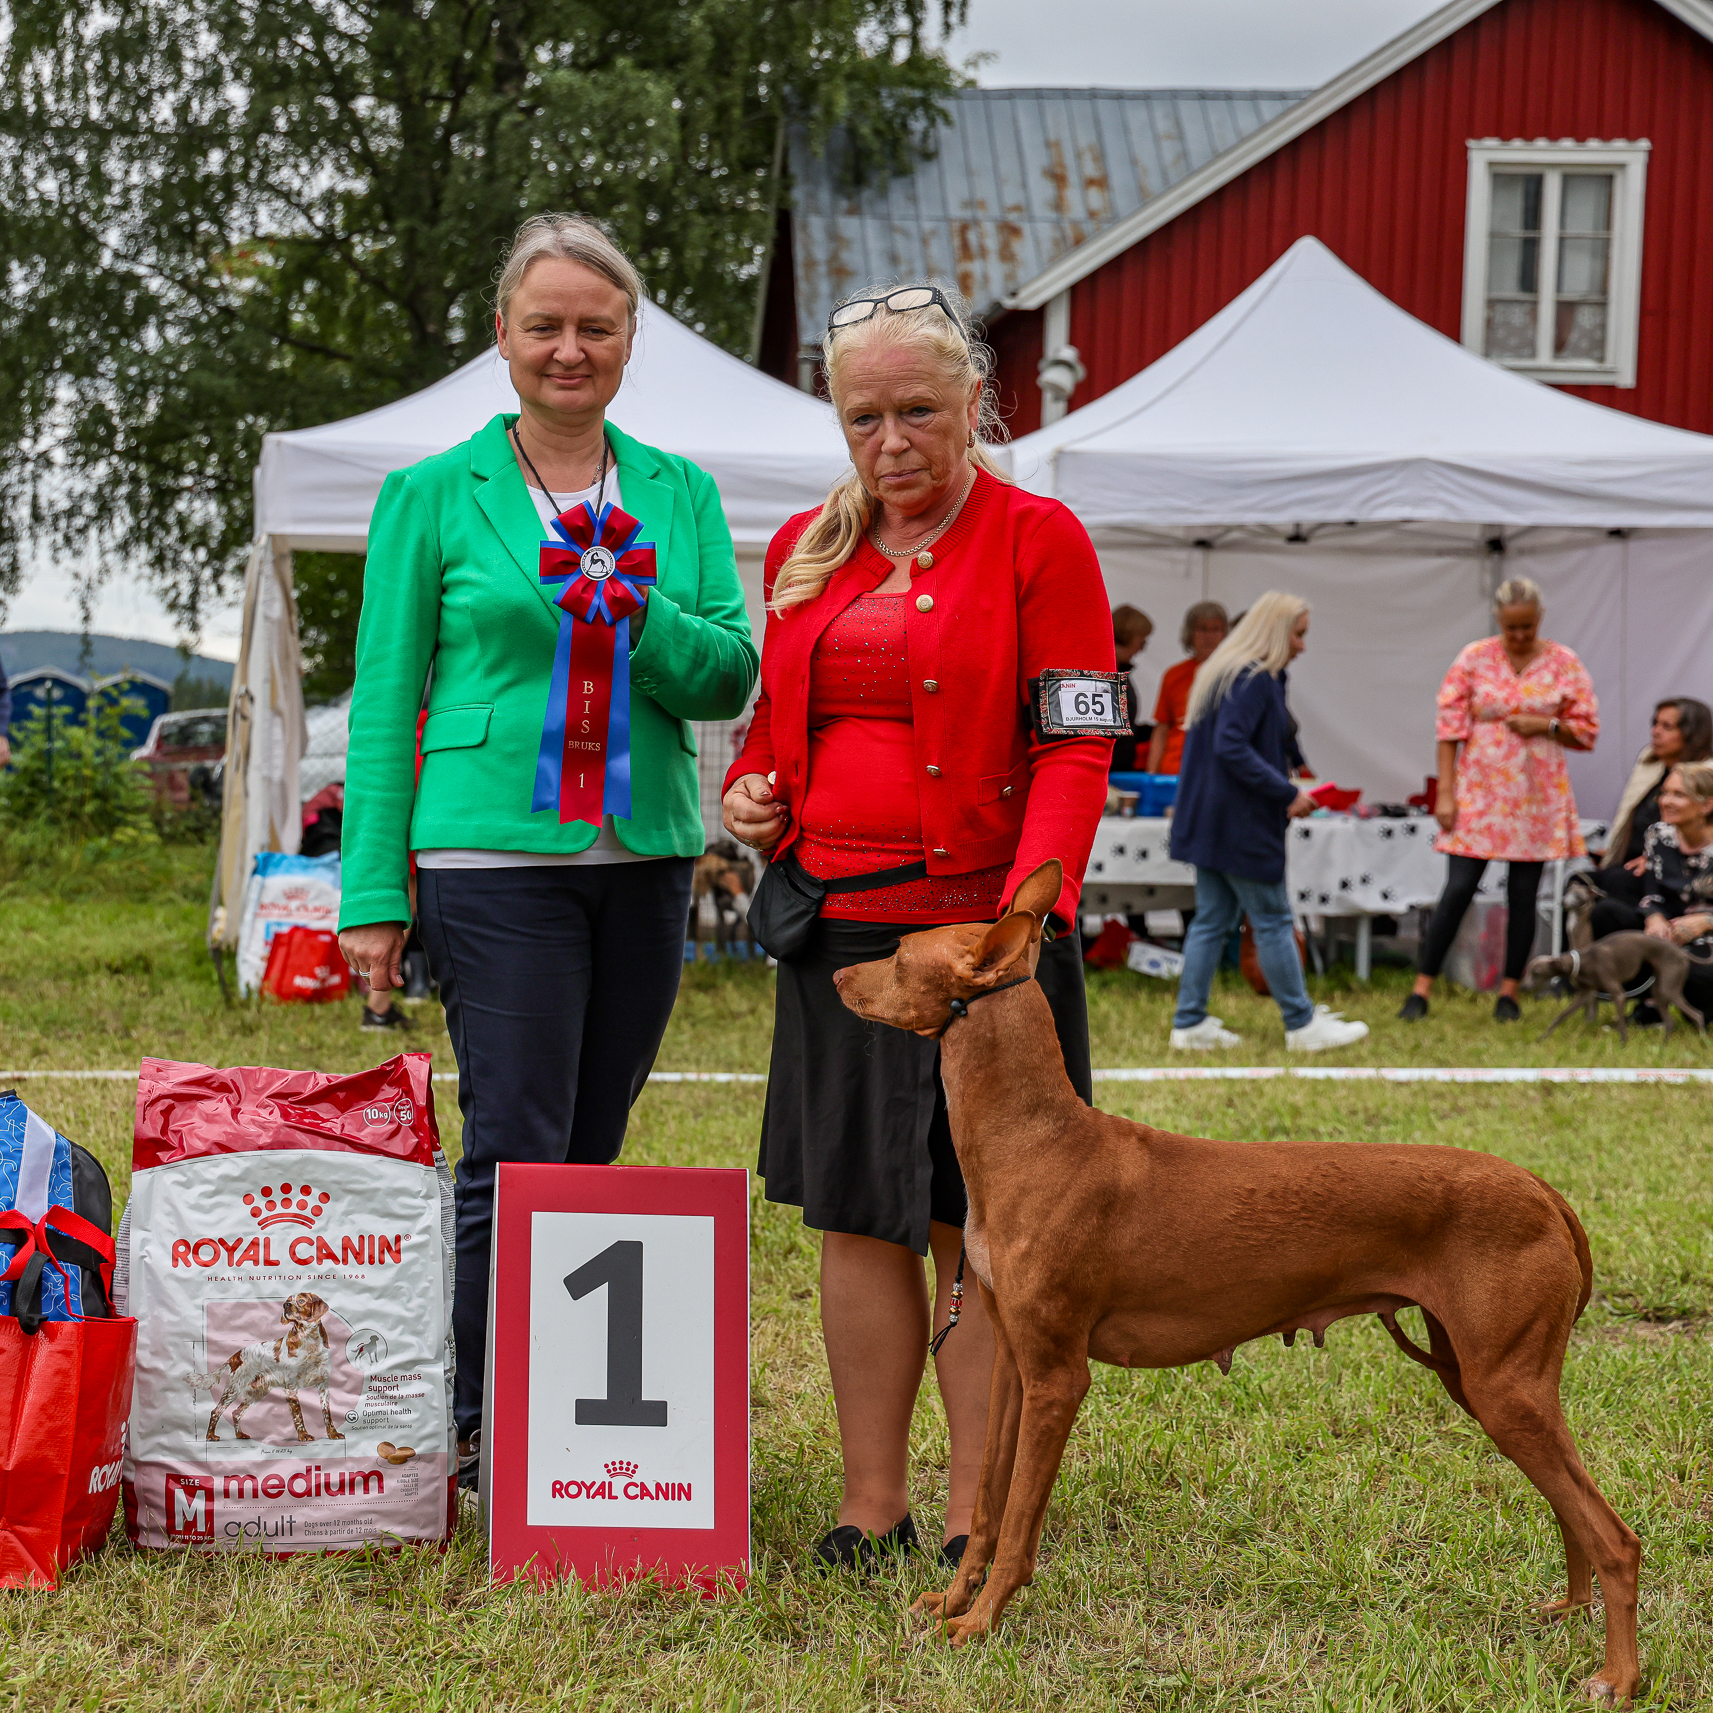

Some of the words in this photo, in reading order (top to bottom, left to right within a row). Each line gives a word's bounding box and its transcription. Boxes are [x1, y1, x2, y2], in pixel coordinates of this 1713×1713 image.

[1074, 692, 1105, 716] 65
[568, 741, 601, 752] BRUKS
[579, 773, 585, 788] 1
[400, 1110, 412, 1121] 50
[172, 1236, 280, 1269] ROYAL
[563, 1240, 668, 1427] 1
[370, 1374, 398, 1382] Muscle
[401, 1373, 422, 1381] mass
[368, 1384, 399, 1393] support
[363, 1410, 389, 1418] Optimal
[363, 1417, 389, 1425] support
[180, 1478, 200, 1486] SIZE
[224, 1466, 384, 1499] medium
[551, 1480, 618, 1500] ROYAL
[623, 1481, 692, 1501] CANIN
[174, 1488, 206, 1532] M
[224, 1515, 296, 1537] adult
[330, 1528, 345, 1536] partir
